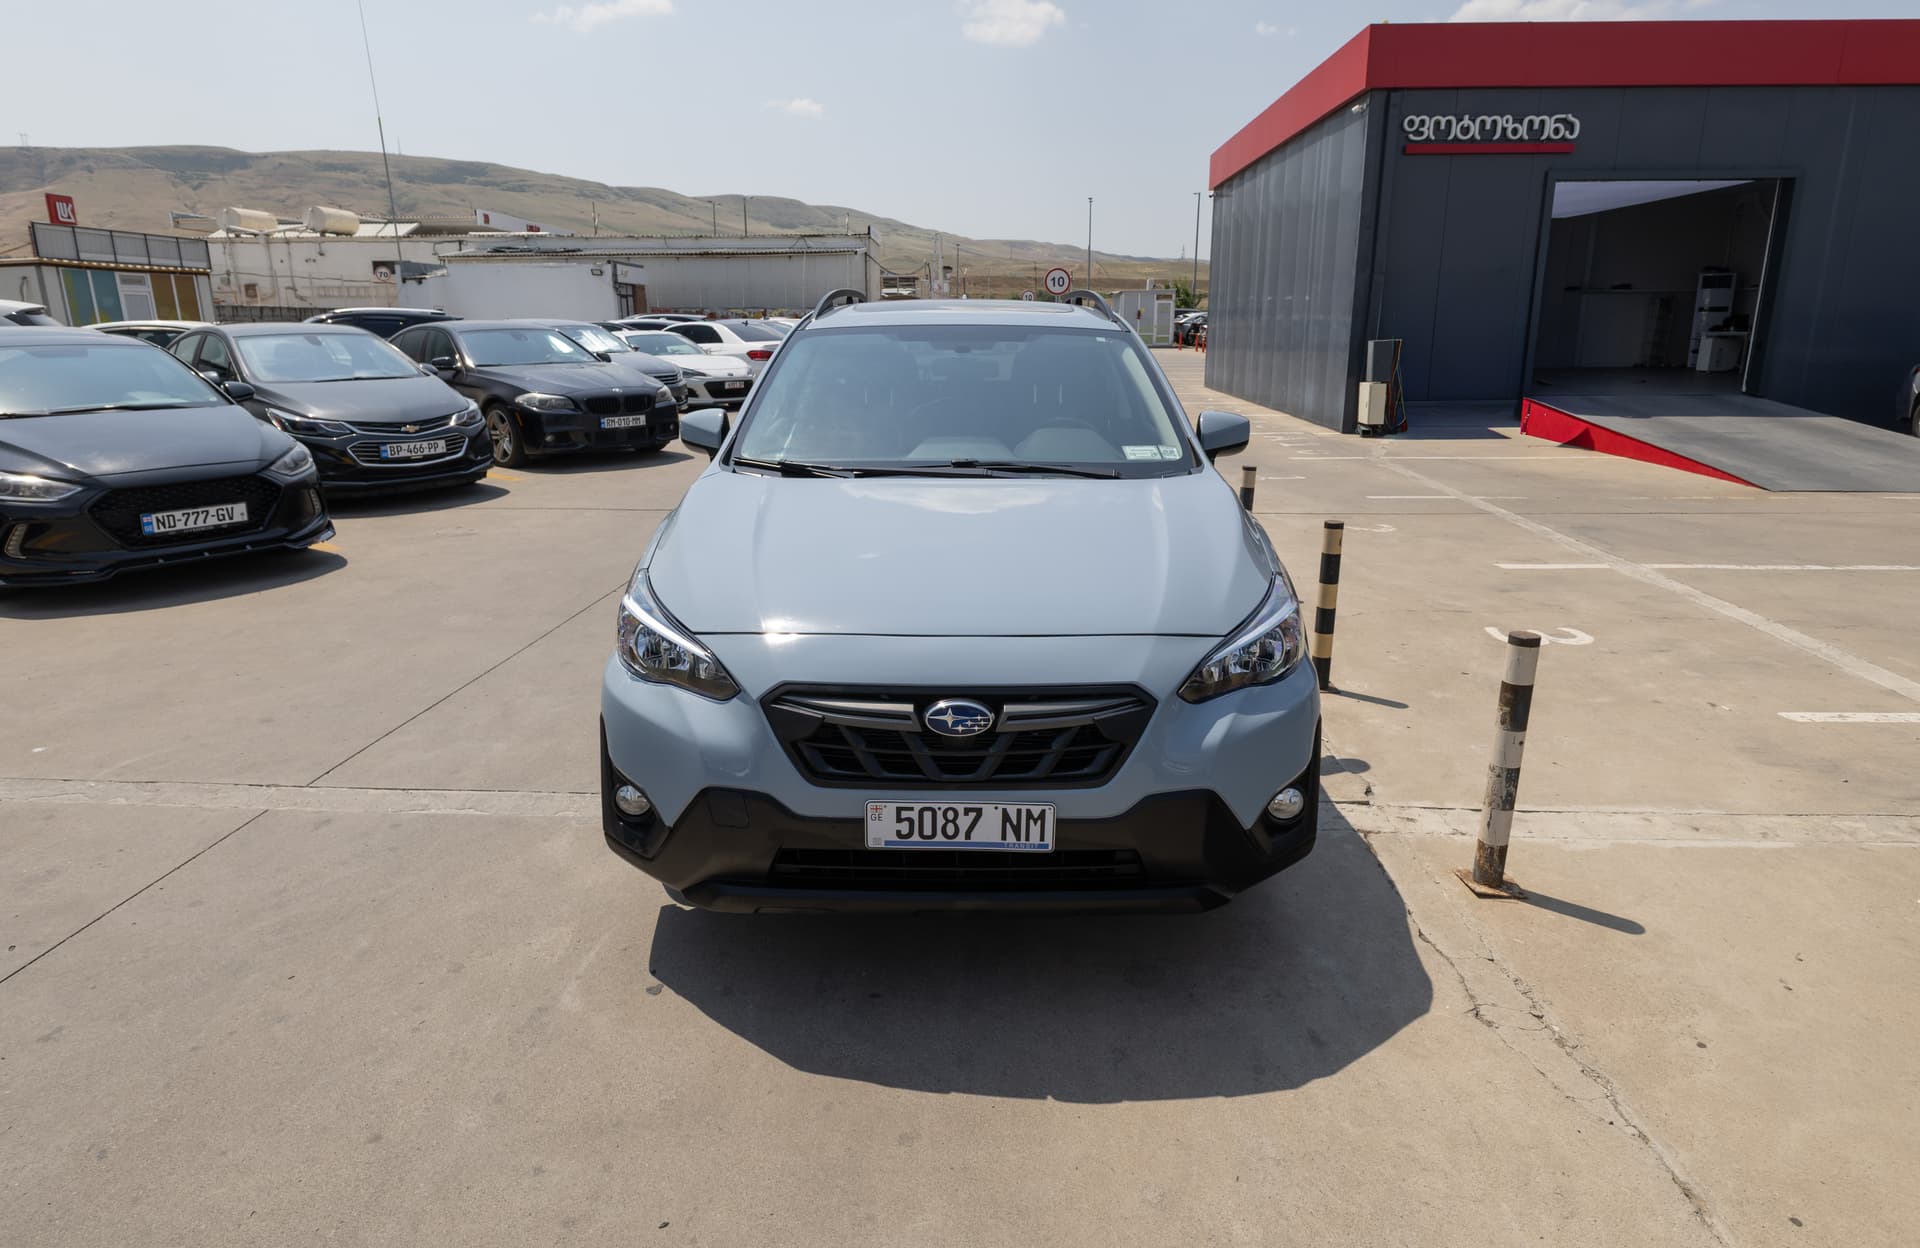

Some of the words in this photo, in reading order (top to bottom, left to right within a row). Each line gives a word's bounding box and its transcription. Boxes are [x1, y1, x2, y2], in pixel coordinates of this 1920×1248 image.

[1403, 114, 1581, 141] ფოტოზონა
[1051, 276, 1065, 288] 10
[388, 441, 439, 457] BP-466-PP
[155, 506, 234, 530] ND-777-GV
[870, 813, 883, 822] GE
[895, 806, 983, 841] 5087
[1001, 807, 1046, 842] NM
